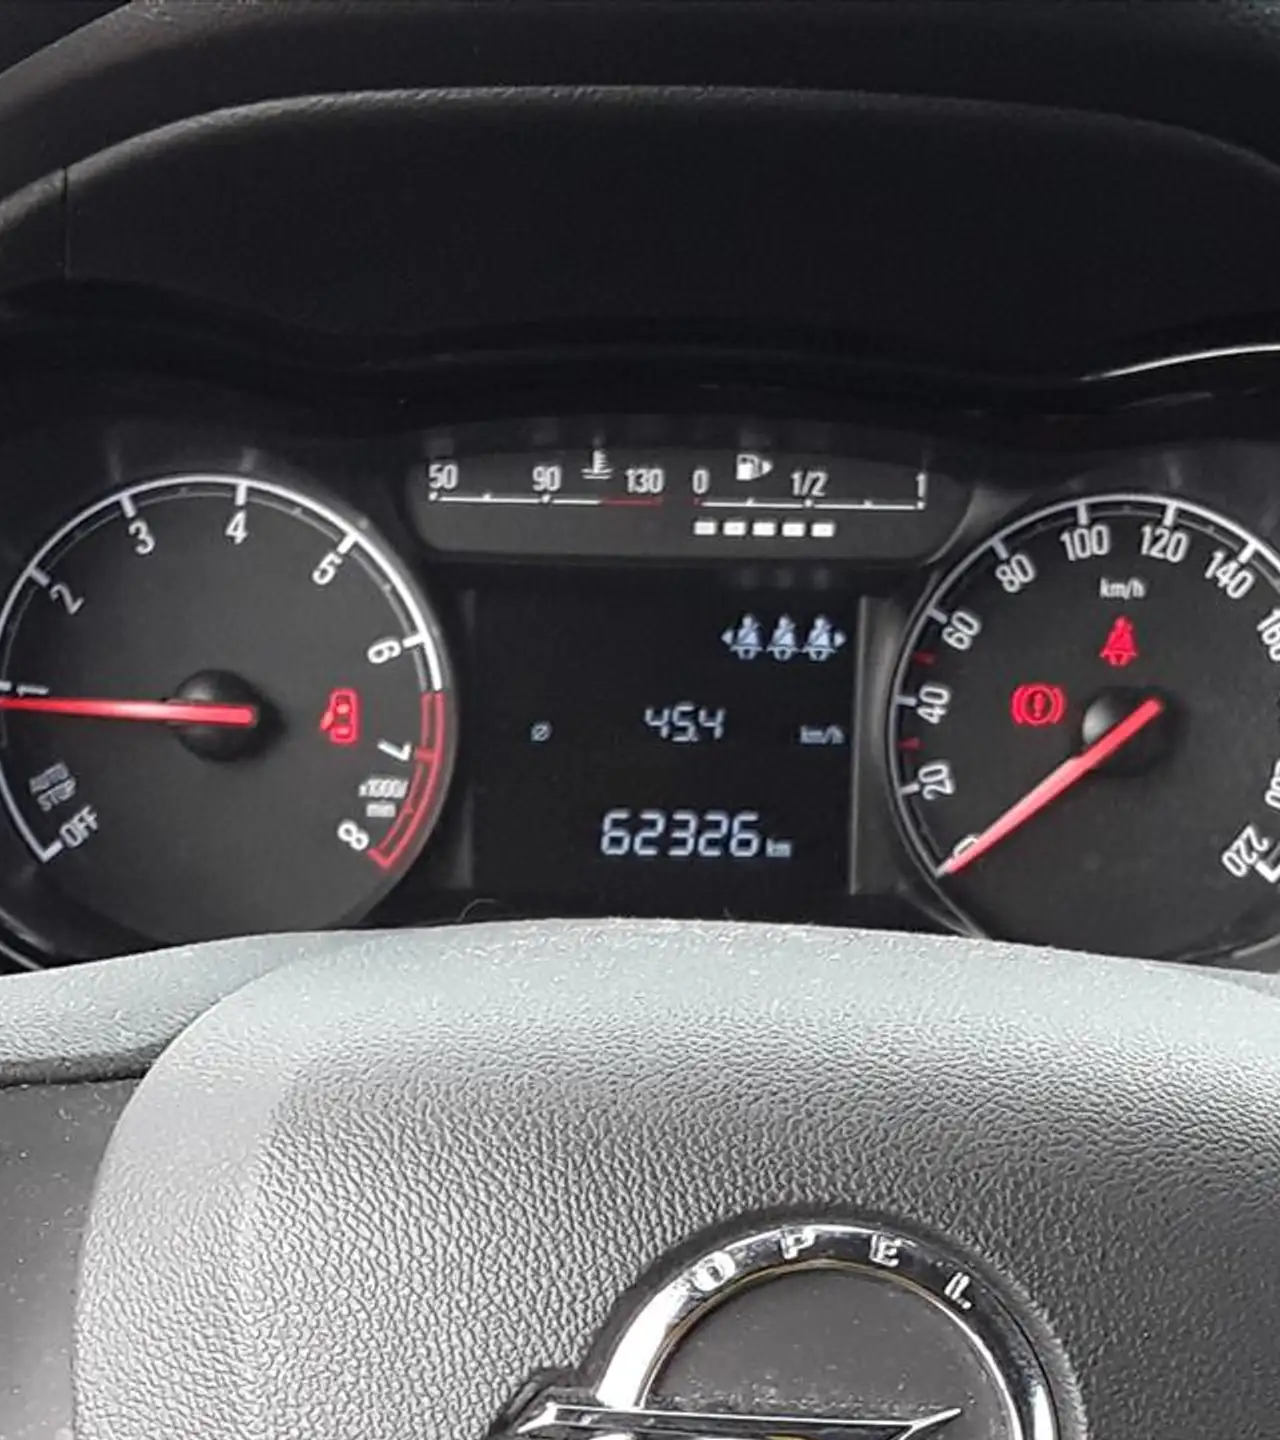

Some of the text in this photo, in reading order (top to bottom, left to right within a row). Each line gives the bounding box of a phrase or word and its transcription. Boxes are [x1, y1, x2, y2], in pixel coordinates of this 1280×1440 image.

[428, 464, 458, 489] 50
[532, 465, 561, 491] 90
[625, 468, 663, 493] 130
[692, 468, 709, 494] 0
[790, 471, 827, 496] 1/2
[916, 473, 927, 498] 1
[126, 519, 155, 555] 3
[224, 511, 248, 544] 4
[1060, 524, 1110, 561] 100
[1140, 525, 1188, 563] 120
[311, 554, 342, 586] 5
[995, 554, 1036, 594] 80
[1202, 549, 1254, 600] 140
[51, 583, 84, 614] 2
[1099, 577, 1145, 598] km/h
[942, 611, 982, 651] 60
[366, 636, 402, 664] 6
[916, 685, 951, 724] 40
[377, 740, 412, 762] 7
[920, 762, 955, 800] 20
[60, 804, 99, 849] OFF
[337, 820, 370, 851] 8
[601, 810, 760, 857] 62326
[1221, 826, 1270, 878] 220
[692, 1226, 972, 1310] OPEL
